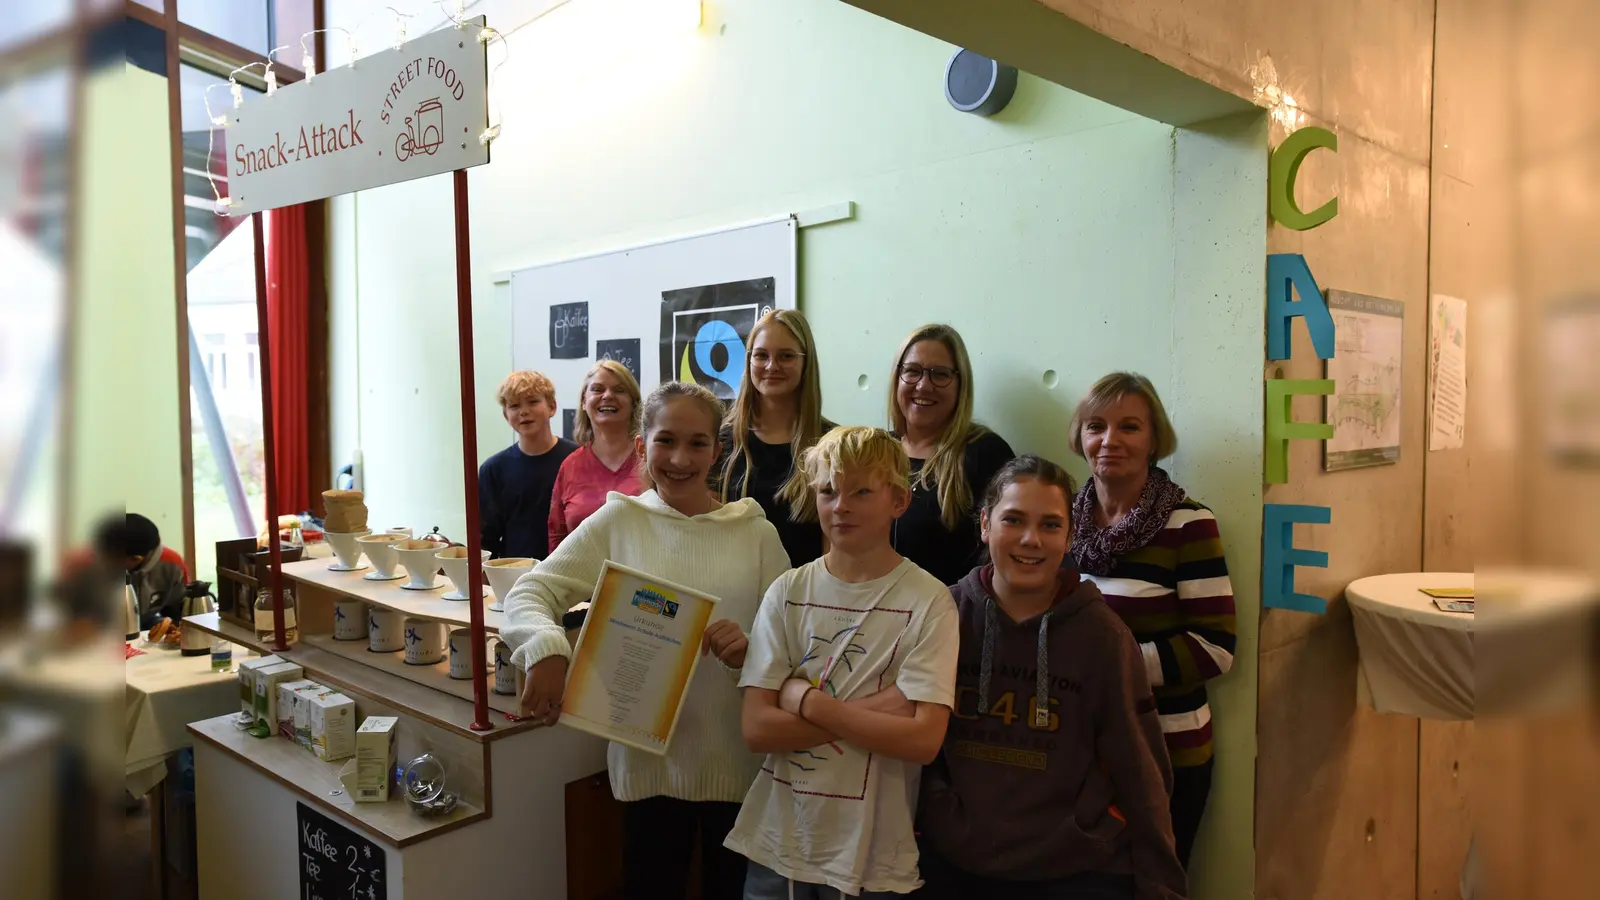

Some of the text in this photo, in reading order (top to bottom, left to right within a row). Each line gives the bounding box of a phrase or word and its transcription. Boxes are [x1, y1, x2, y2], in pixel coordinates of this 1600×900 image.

[380, 57, 464, 124] STREET FOOD
[235, 109, 363, 177] Snack-Attack
[1263, 126, 1338, 614] CAFE
[302, 820, 338, 862] Kaffee
[302, 852, 320, 881] Tee
